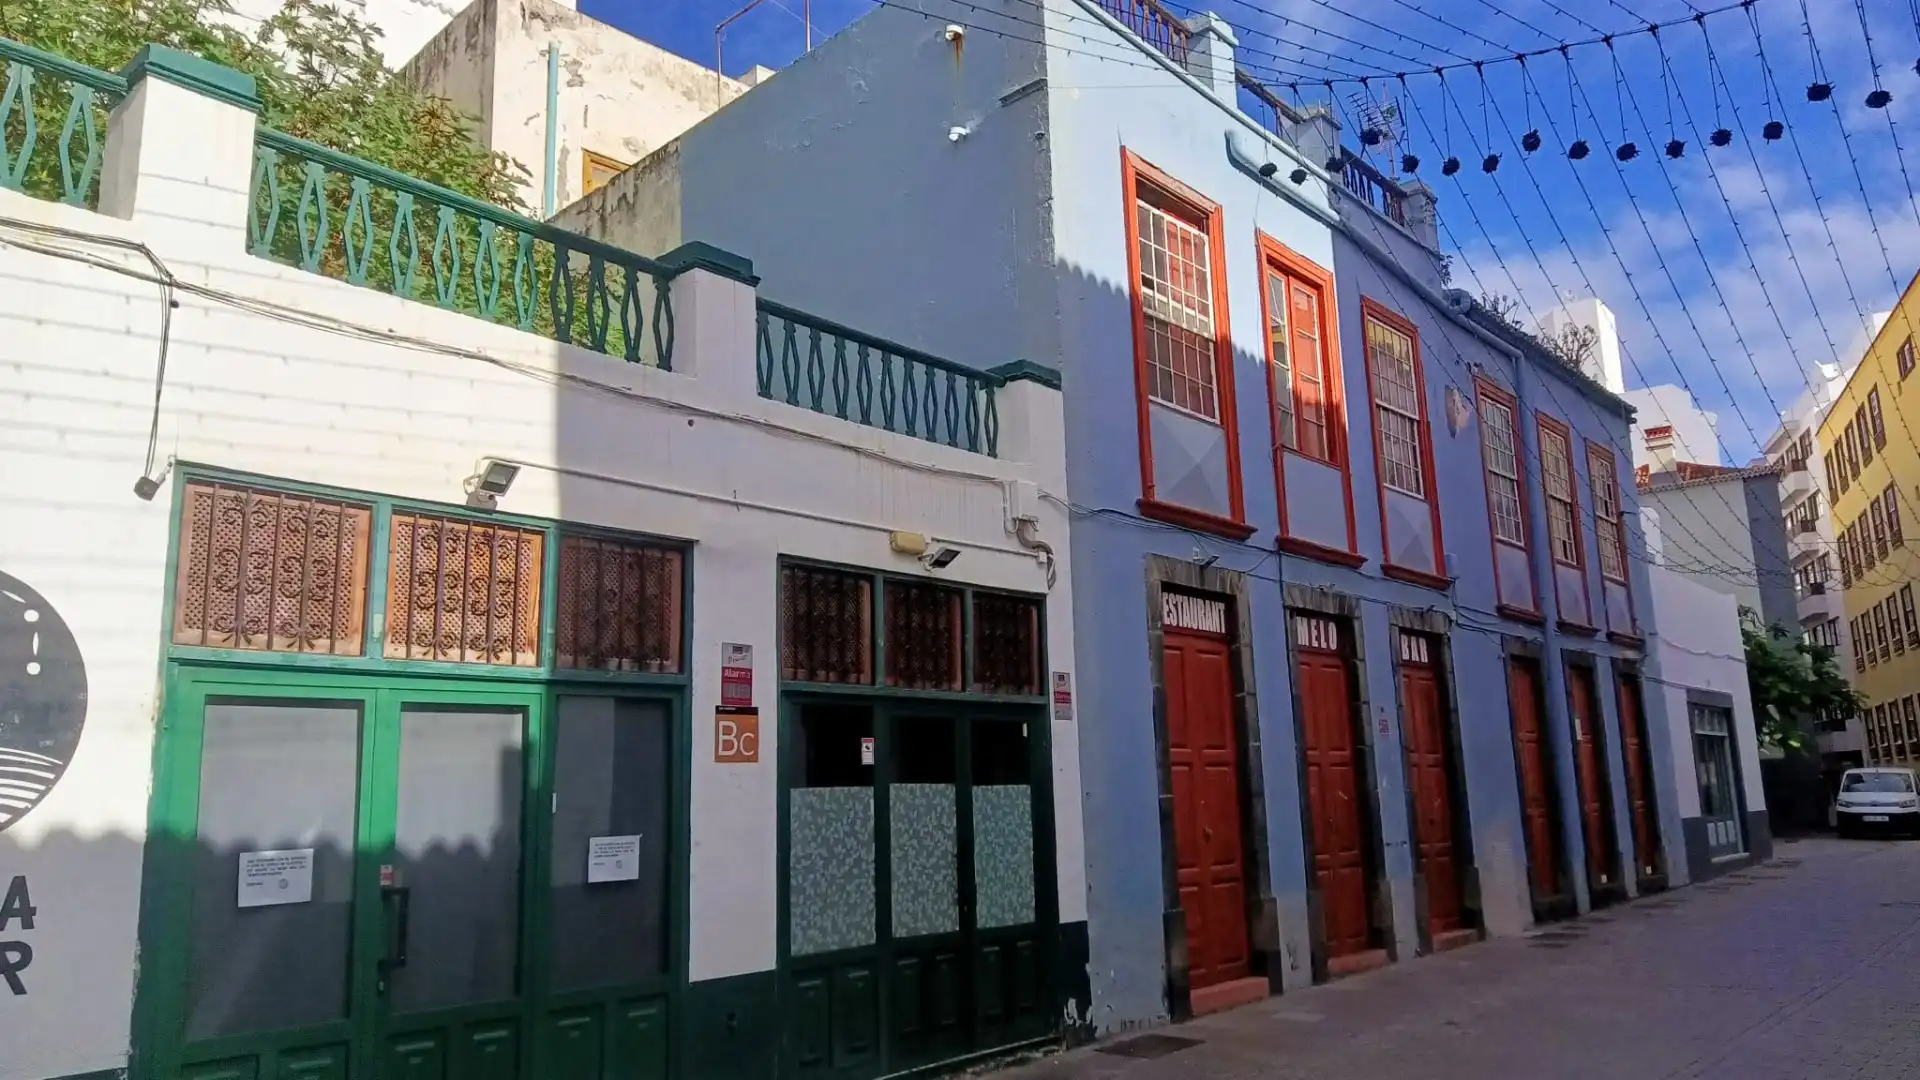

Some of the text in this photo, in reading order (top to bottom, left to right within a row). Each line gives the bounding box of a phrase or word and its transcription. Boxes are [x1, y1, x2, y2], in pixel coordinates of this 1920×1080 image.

[1296, 616, 1338, 650] MELO
[1400, 634, 1428, 663] BAR
[718, 720, 755, 756] Bc
